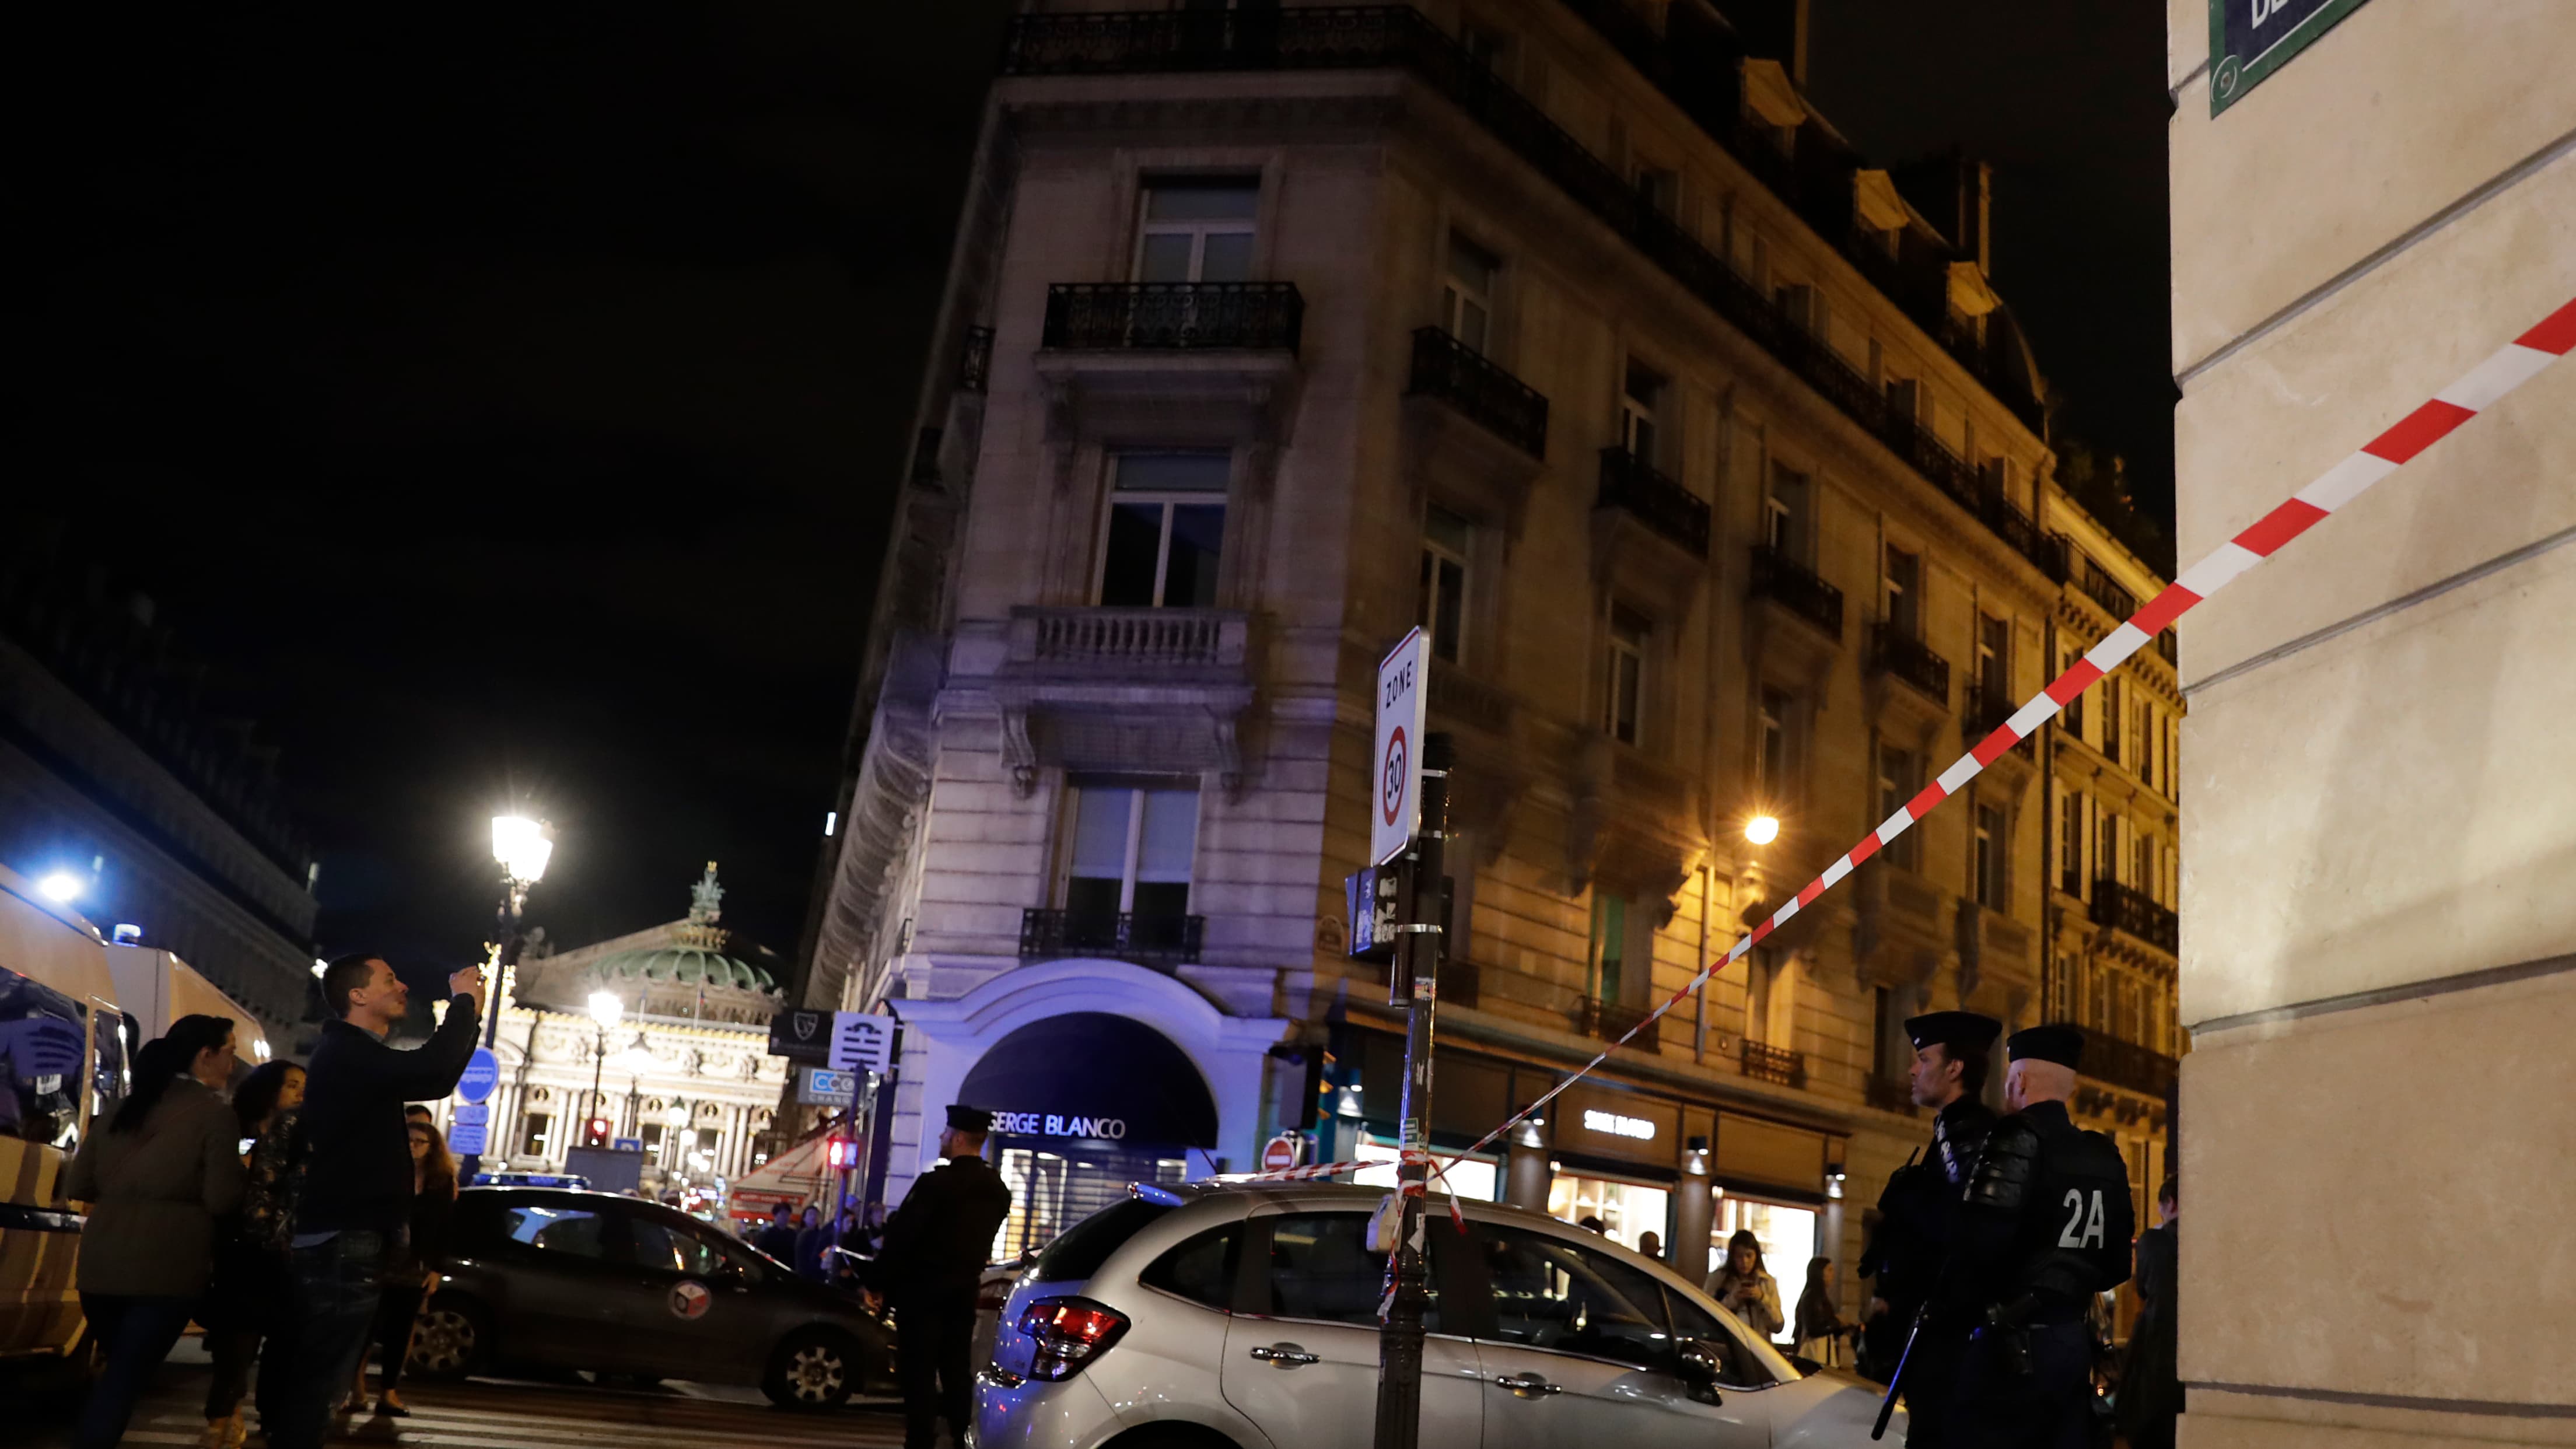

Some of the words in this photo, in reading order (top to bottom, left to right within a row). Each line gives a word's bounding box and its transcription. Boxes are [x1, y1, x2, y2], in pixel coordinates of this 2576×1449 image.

[1386, 660, 1412, 710] ZONE
[1387, 753, 1402, 799] 30
[988, 1111, 1040, 1135] SERGE
[1044, 1115, 1126, 1139] BLANCO
[2057, 1188, 2105, 1249] 2A
